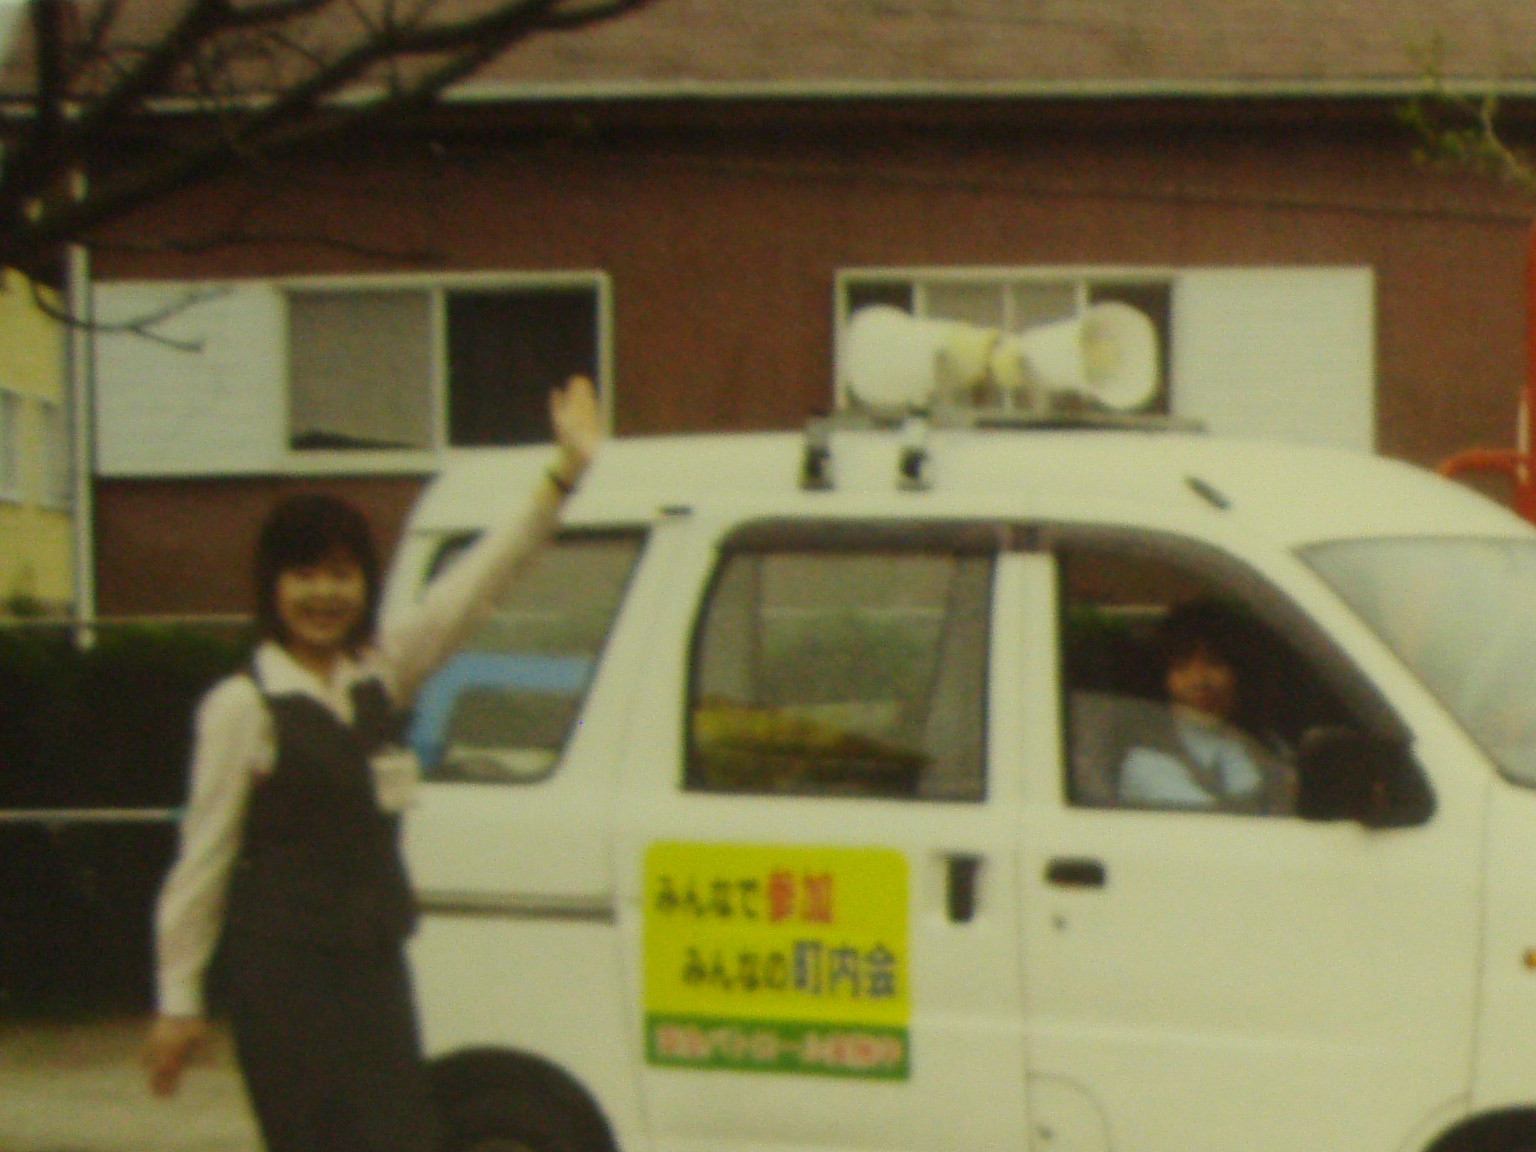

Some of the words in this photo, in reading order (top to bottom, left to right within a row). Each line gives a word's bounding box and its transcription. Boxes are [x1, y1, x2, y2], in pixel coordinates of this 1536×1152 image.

[683, 940, 896, 998] みんなの町内会
